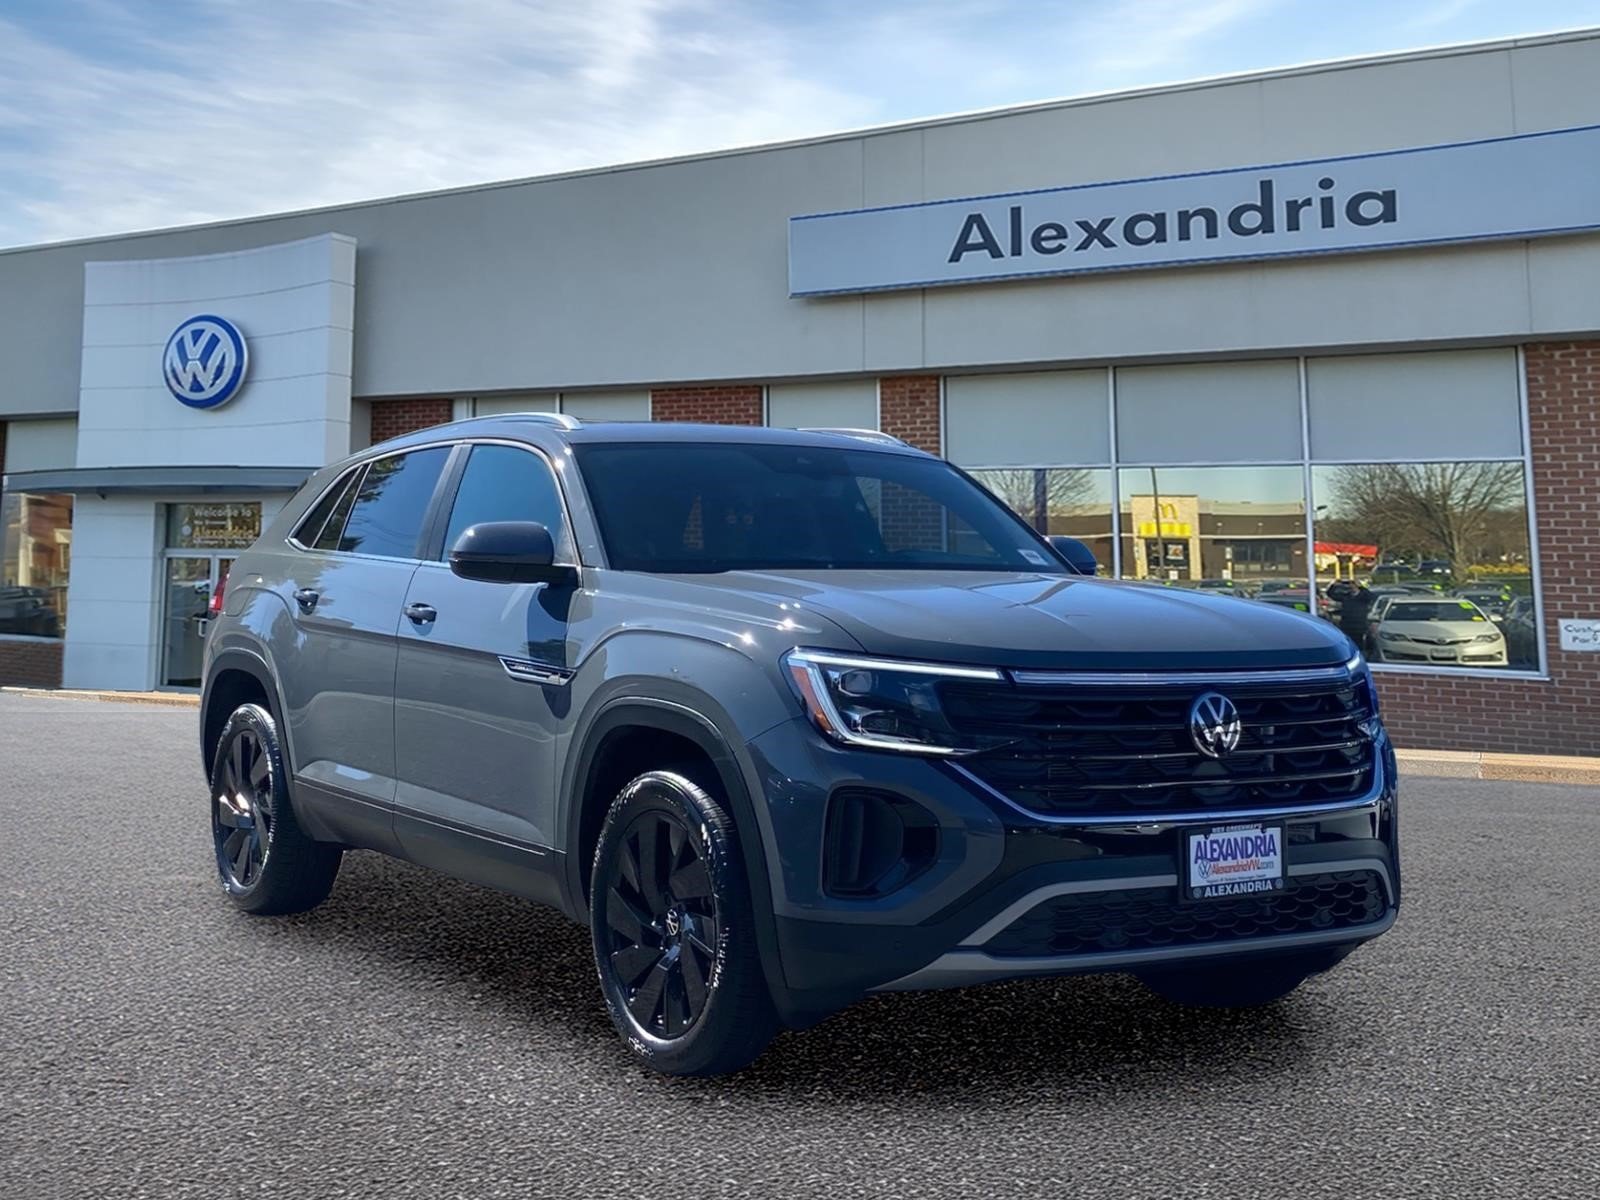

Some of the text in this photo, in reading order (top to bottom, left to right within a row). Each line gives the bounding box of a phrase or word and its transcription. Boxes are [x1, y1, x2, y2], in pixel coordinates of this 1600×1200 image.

[947, 177, 1398, 263] Alexandria
[164, 316, 242, 404] VW
[1190, 692, 1241, 758] VW
[1194, 834, 1277, 863] ALEXANDRIA
[1204, 880, 1273, 898] ALEXANDRIA
